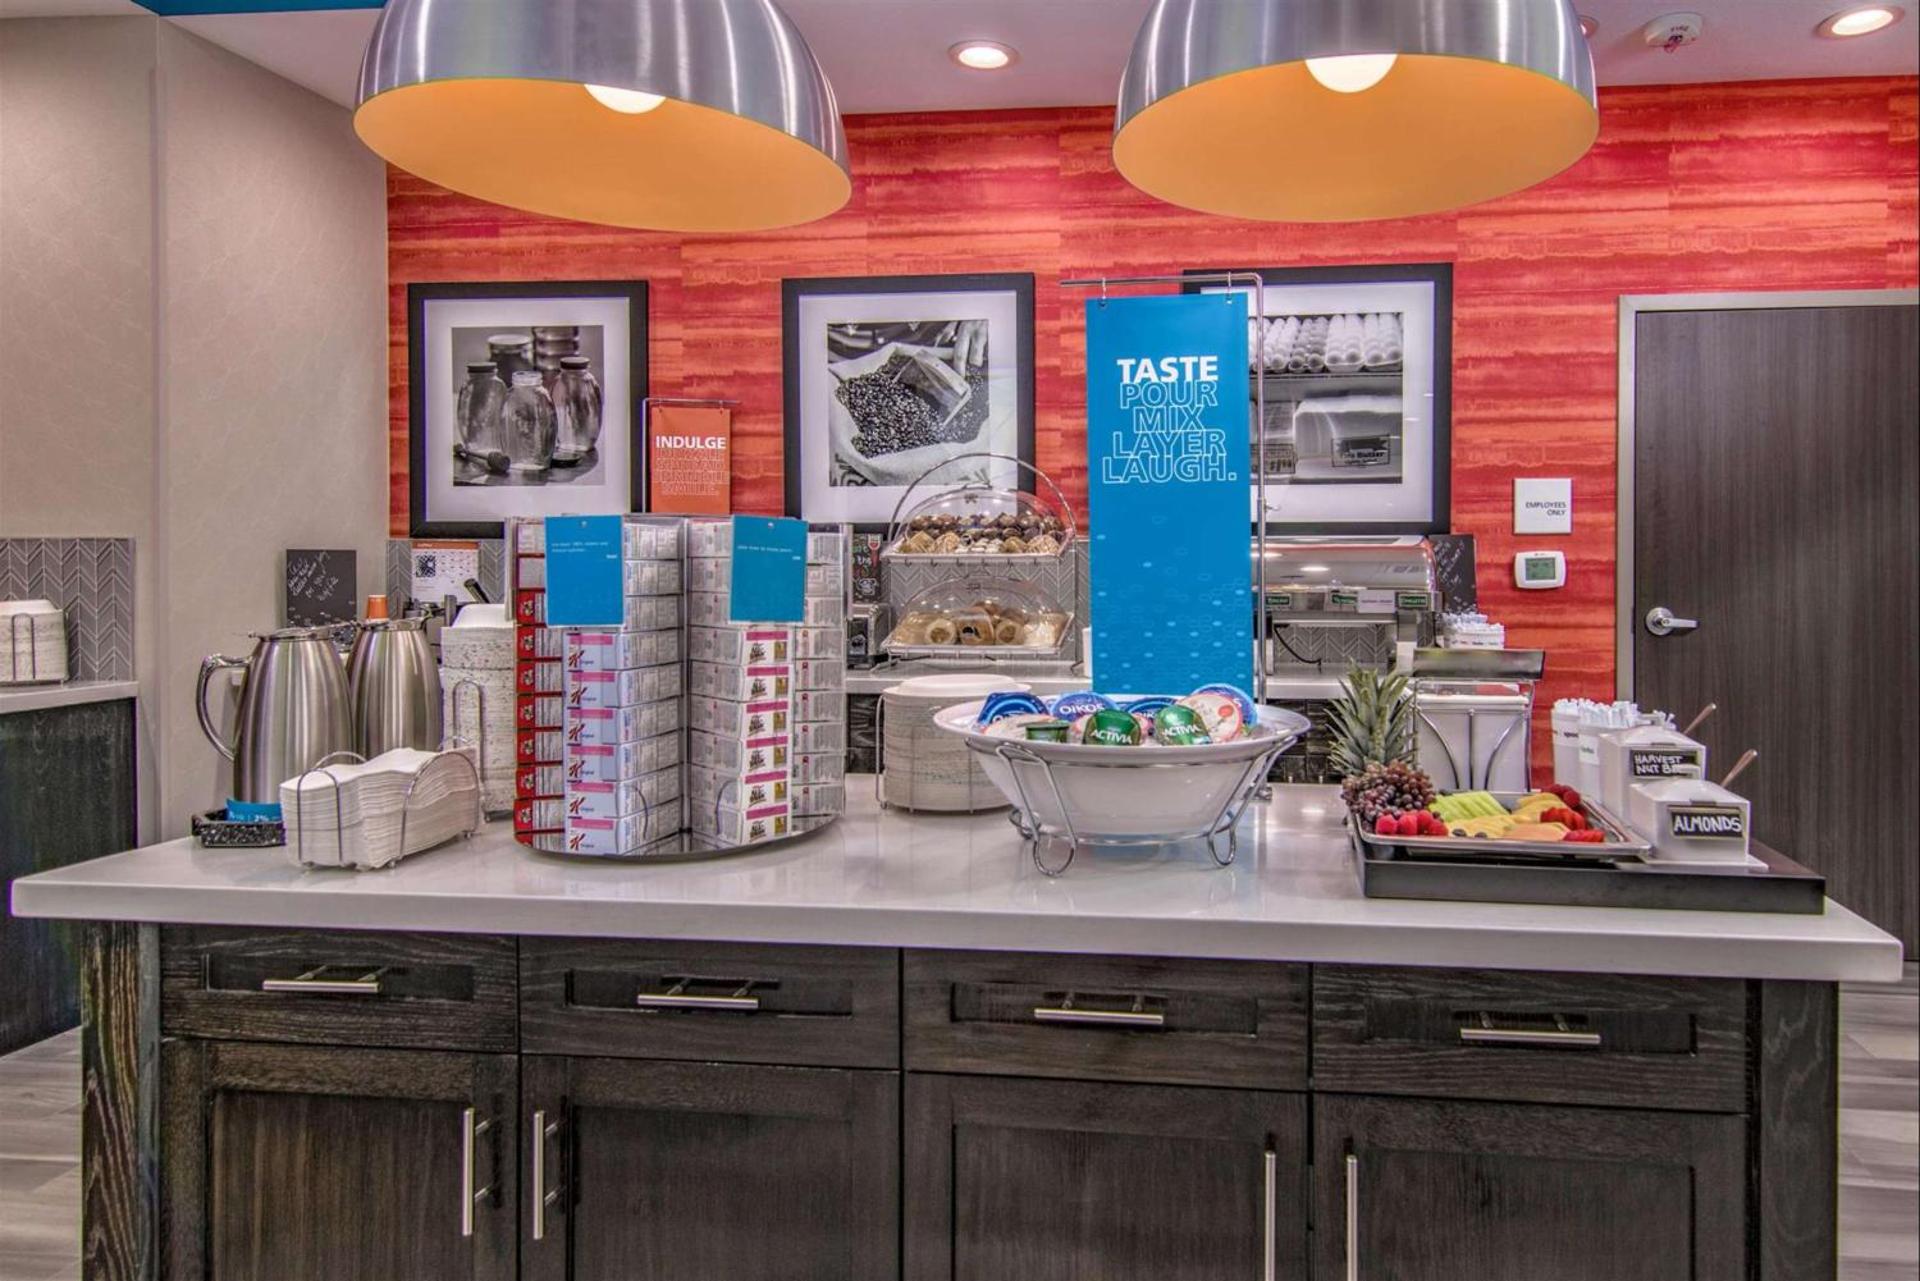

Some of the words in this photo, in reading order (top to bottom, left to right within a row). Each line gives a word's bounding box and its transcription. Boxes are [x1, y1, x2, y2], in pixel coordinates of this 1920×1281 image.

[1117, 355, 1219, 383] TASTE
[1120, 381, 1218, 409] POUR
[1133, 405, 1205, 433] MIX
[656, 435, 727, 449] INDULGE
[1113, 429, 1227, 458] LAYER
[1102, 454, 1237, 484] LAUGH.
[1525, 501, 1567, 509] EMPLOYEES
[1090, 729, 1133, 745] ACTIVIA
[1634, 754, 1683, 765] HARVEST
[1635, 764, 1660, 775] NUT
[1673, 815, 1743, 833] ALMONDS
